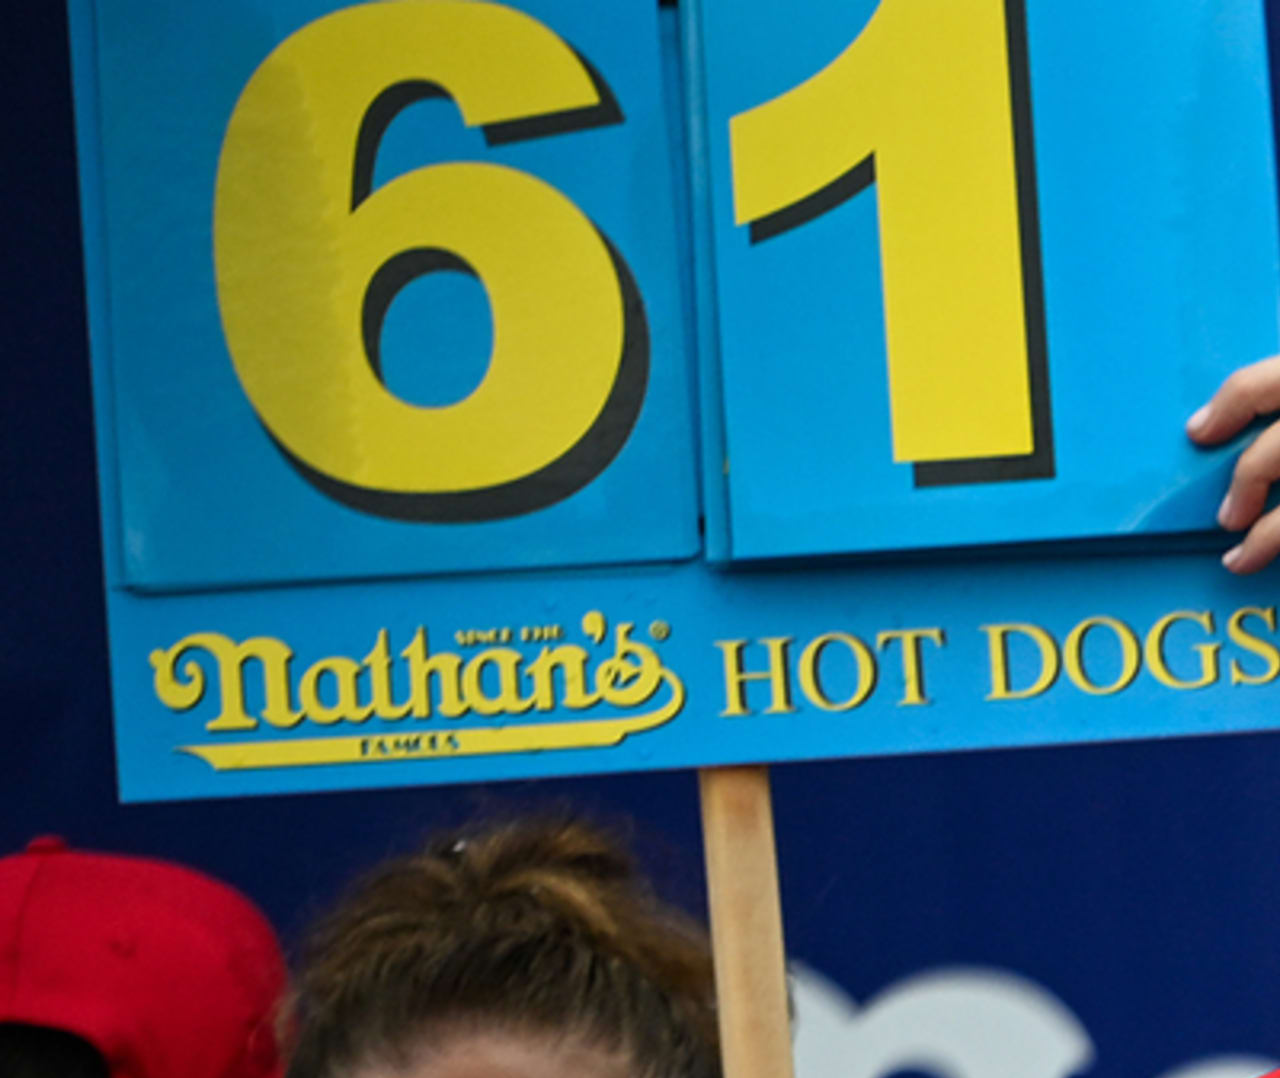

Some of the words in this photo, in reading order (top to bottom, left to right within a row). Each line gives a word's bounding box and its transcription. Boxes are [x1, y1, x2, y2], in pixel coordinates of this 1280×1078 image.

[213, 0, 1055, 524] 61
[149, 610, 665, 732] Nathan's
[714, 627, 947, 718] HOT
